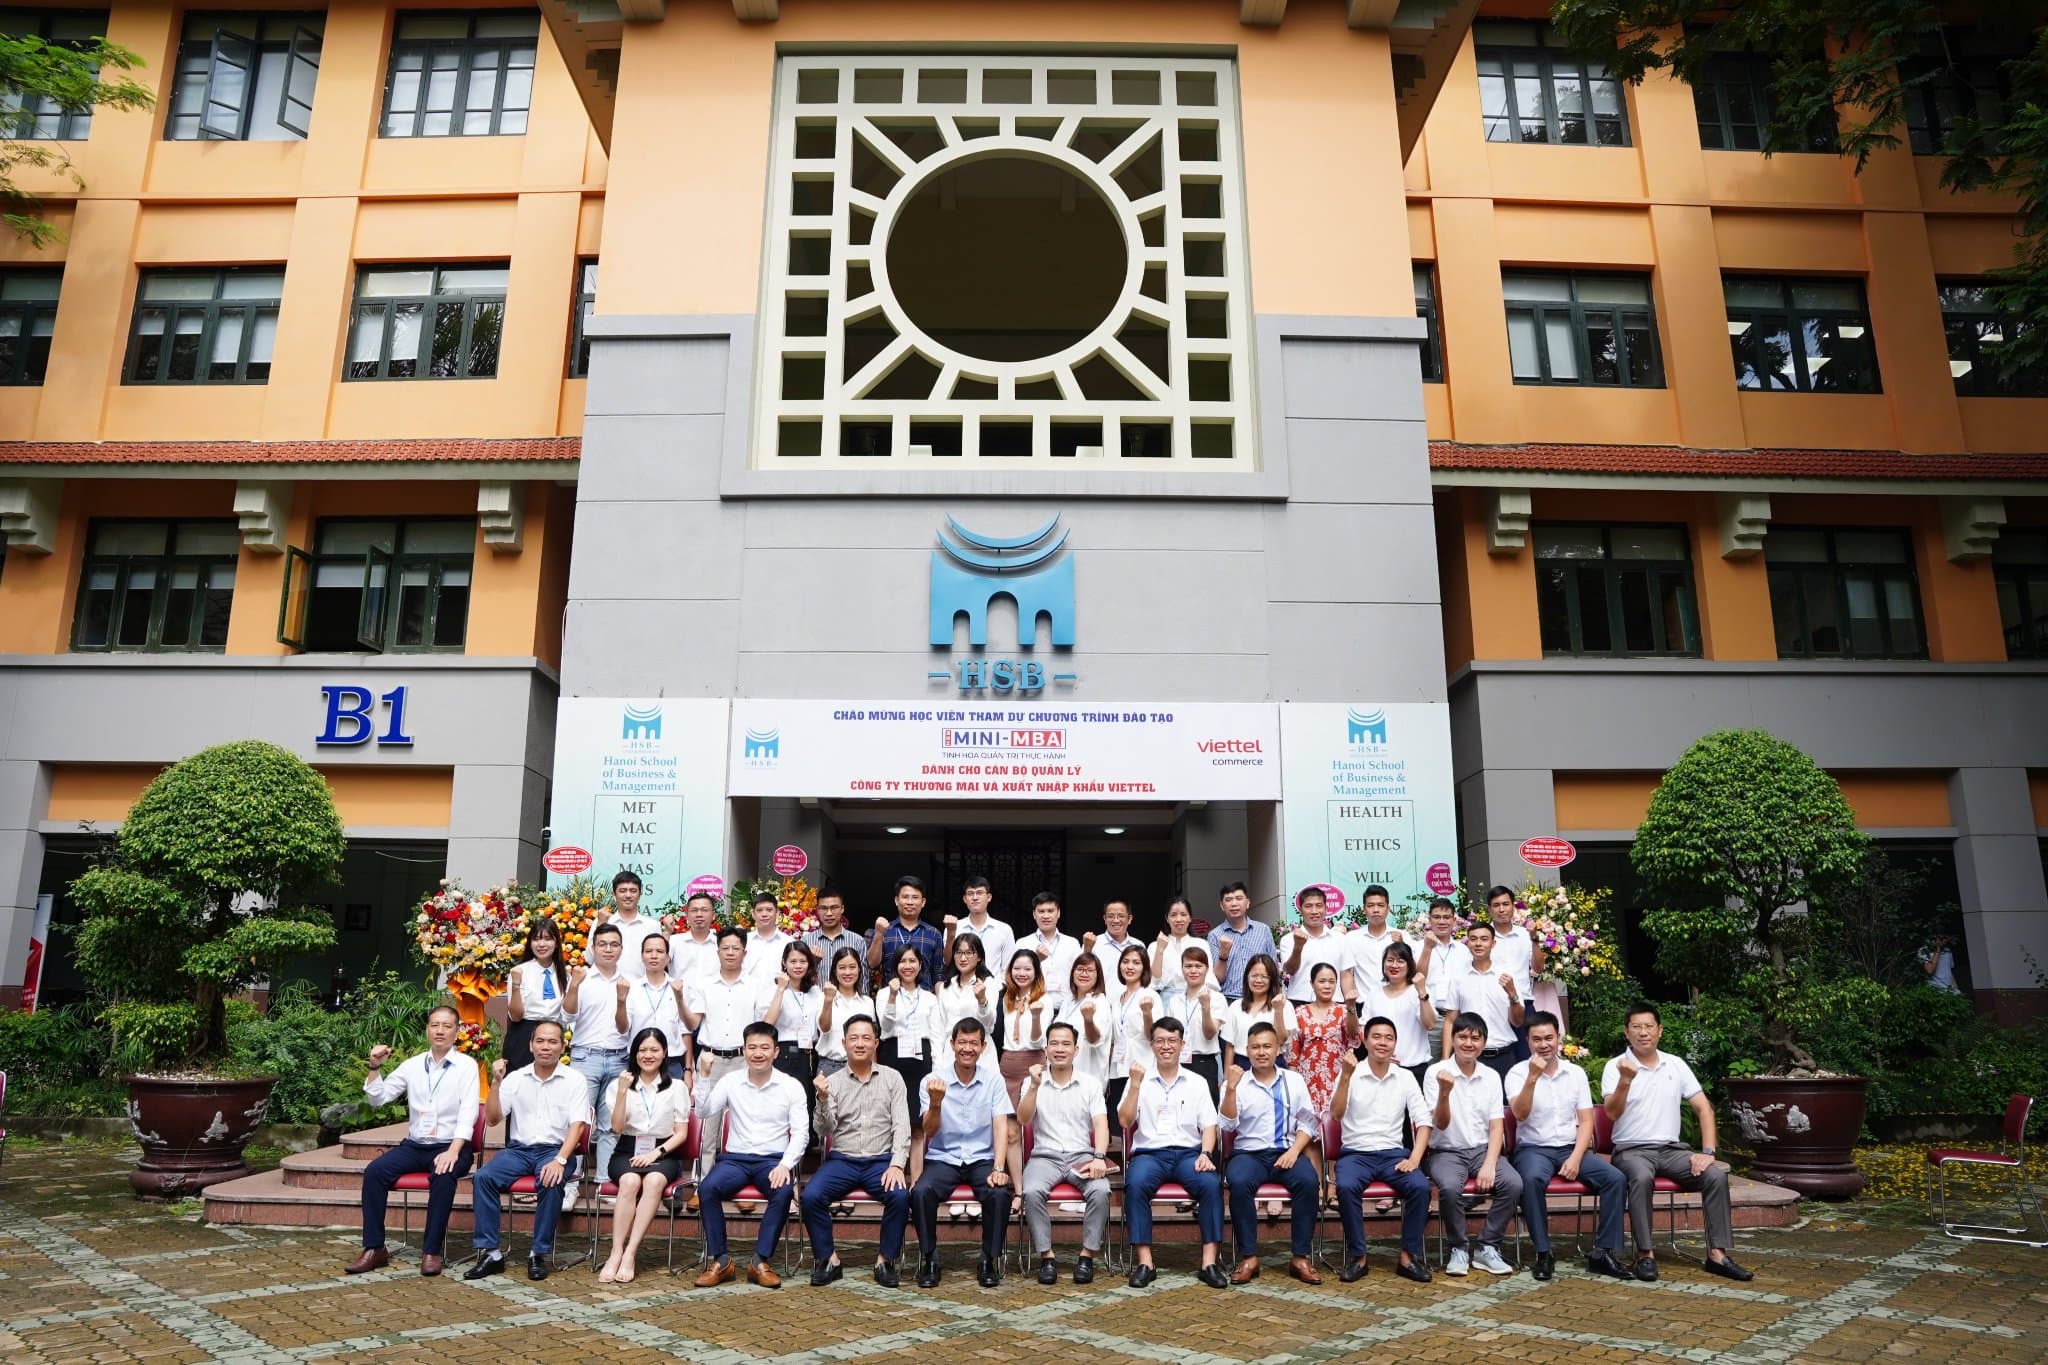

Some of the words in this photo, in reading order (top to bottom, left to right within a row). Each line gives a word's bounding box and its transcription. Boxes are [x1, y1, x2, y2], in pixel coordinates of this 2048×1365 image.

[957, 659, 1046, 690] HSB
[315, 684, 414, 744] B1
[834, 710, 864, 721] CHÀO
[868, 710, 906, 721] MỪNG
[909, 711, 932, 722] HỌC
[936, 710, 964, 722] VIÊN
[968, 712, 1004, 722] THAM
[1008, 712, 1024, 723] DỰ
[1028, 712, 1078, 722] CHƯƠNG
[1082, 710, 1119, 722] TRÌNH
[1150, 713, 1174, 724] TẠO
[954, 731, 1061, 747] MINI-MBA
[1197, 739, 1262, 752] viettel
[604, 756, 636, 766] Hanoi
[640, 756, 676, 767] School
[1332, 760, 1364, 770] Hanoi
[1369, 760, 1404, 770] School
[602, 768, 614, 778] of
[617, 768, 664, 778] Business
[668, 769, 677, 778] &
[922, 764, 954, 775] DÀNH
[958, 765, 980, 775] CHO
[1012, 764, 1028, 777] BỘ
[1067, 764, 1082, 776] LÝ
[1332, 772, 1344, 782] of
[1348, 772, 1394, 782] Business
[1396, 773, 1406, 782] &
[602, 780, 676, 793] Management
[850, 780, 882, 790] CÔNG
[885, 781, 900, 790] TY
[904, 780, 952, 791] THƯƠNG
[956, 782, 979, 792] MẠI
[1002, 780, 1033, 792] XUẤT
[1036, 780, 1070, 794] NHẬP
[1073, 779, 1104, 792] KHẨU
[1108, 782, 1156, 792] VIETTEL
[1333, 785, 1406, 798] Management
[623, 802, 656, 814] MET
[1340, 806, 1402, 818] HEALTH
[620, 822, 656, 834] MAC
[621, 842, 654, 854] HAT
[1344, 838, 1400, 850] ETHICS
[618, 863, 654, 876] MAS
[1354, 872, 1394, 884] WILL
